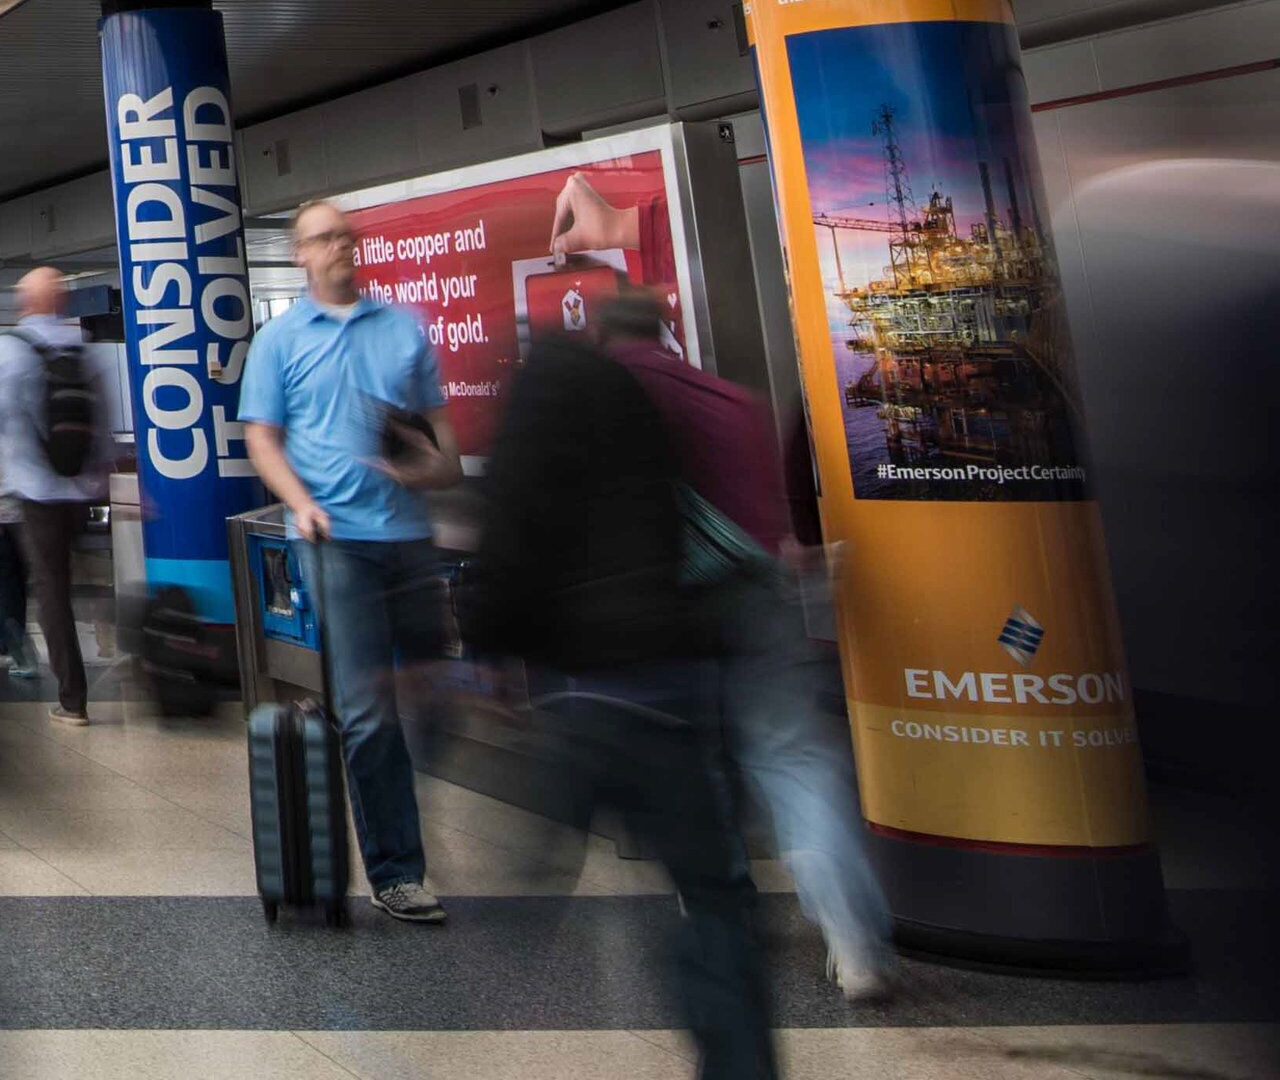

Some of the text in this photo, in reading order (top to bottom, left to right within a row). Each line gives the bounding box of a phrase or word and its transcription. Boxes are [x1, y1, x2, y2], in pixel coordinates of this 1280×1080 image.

[352, 219, 486, 267] a little copper and
[117, 86, 208, 480] CONSIDER
[183, 85, 259, 480] IT SOLVED
[370, 278, 392, 305] the
[395, 272, 438, 304] world
[440, 273, 478, 307] your
[429, 313, 488, 352] of gold.
[904, 668, 1127, 705] EMERSON
[891, 720, 1029, 746] CONSIDER
[1040, 730, 1066, 747] IT
